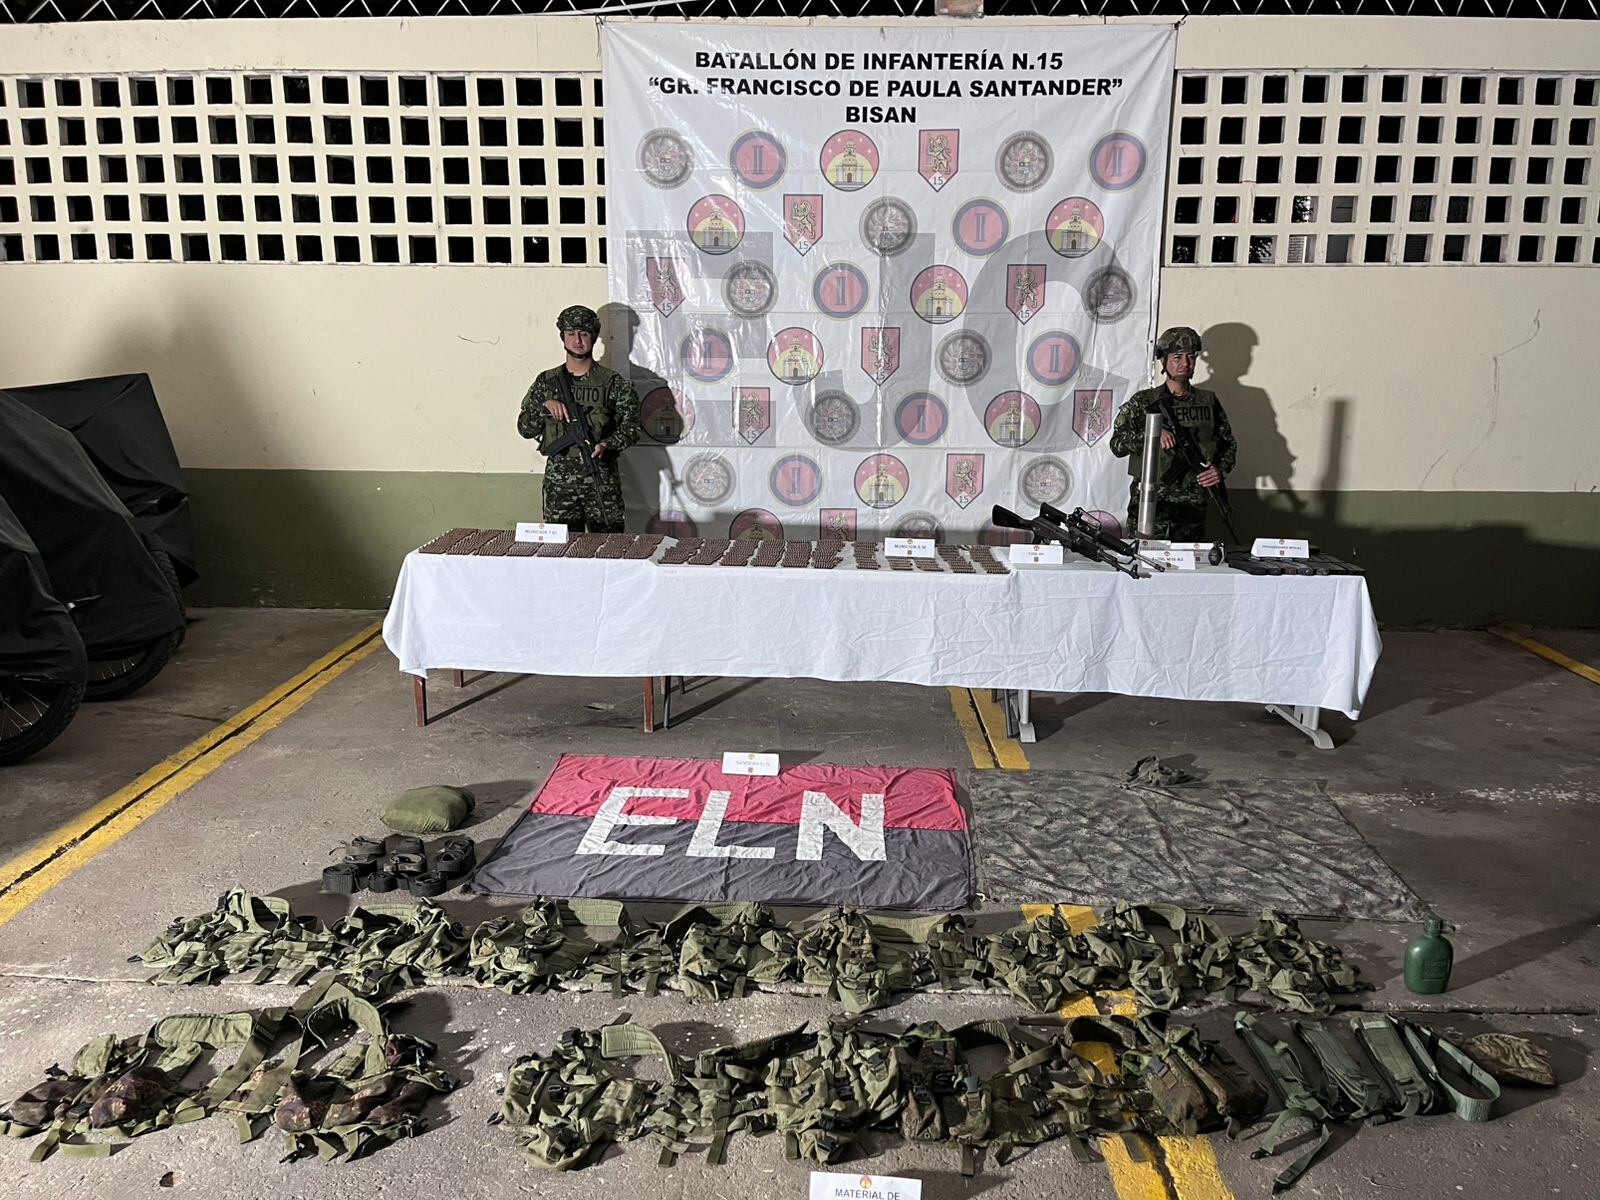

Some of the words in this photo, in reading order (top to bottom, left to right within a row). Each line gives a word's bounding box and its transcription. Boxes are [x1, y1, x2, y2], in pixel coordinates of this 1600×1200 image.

[695, 49, 816, 70] BATALLÓN
[825, 53, 855, 70] DE
[863, 49, 1005, 70] INFANTERÍA
[1012, 52, 1063, 70] N.15
[706, 78, 841, 96] FRANCISCO
[849, 80, 879, 97] DE
[887, 80, 962, 98] PAULA
[845, 106, 917, 124] BISAN
[933, 176, 944, 186] 15
[798, 241, 809, 250] 15
[661, 302, 672, 312] 15
[1019, 310, 1030, 319] 15
[875, 371, 886, 380] 15
[571, 386, 599, 403] RCITO
[1174, 406, 1211, 422] ERCITO
[746, 430, 757, 439] 15
[1086, 433, 1097, 442] 15
[959, 495, 969, 504] 15
[576, 786, 887, 861] ELN
[834, 1188, 885, 1200] MATERIAL
[887, 1191, 900, 1200] DE
